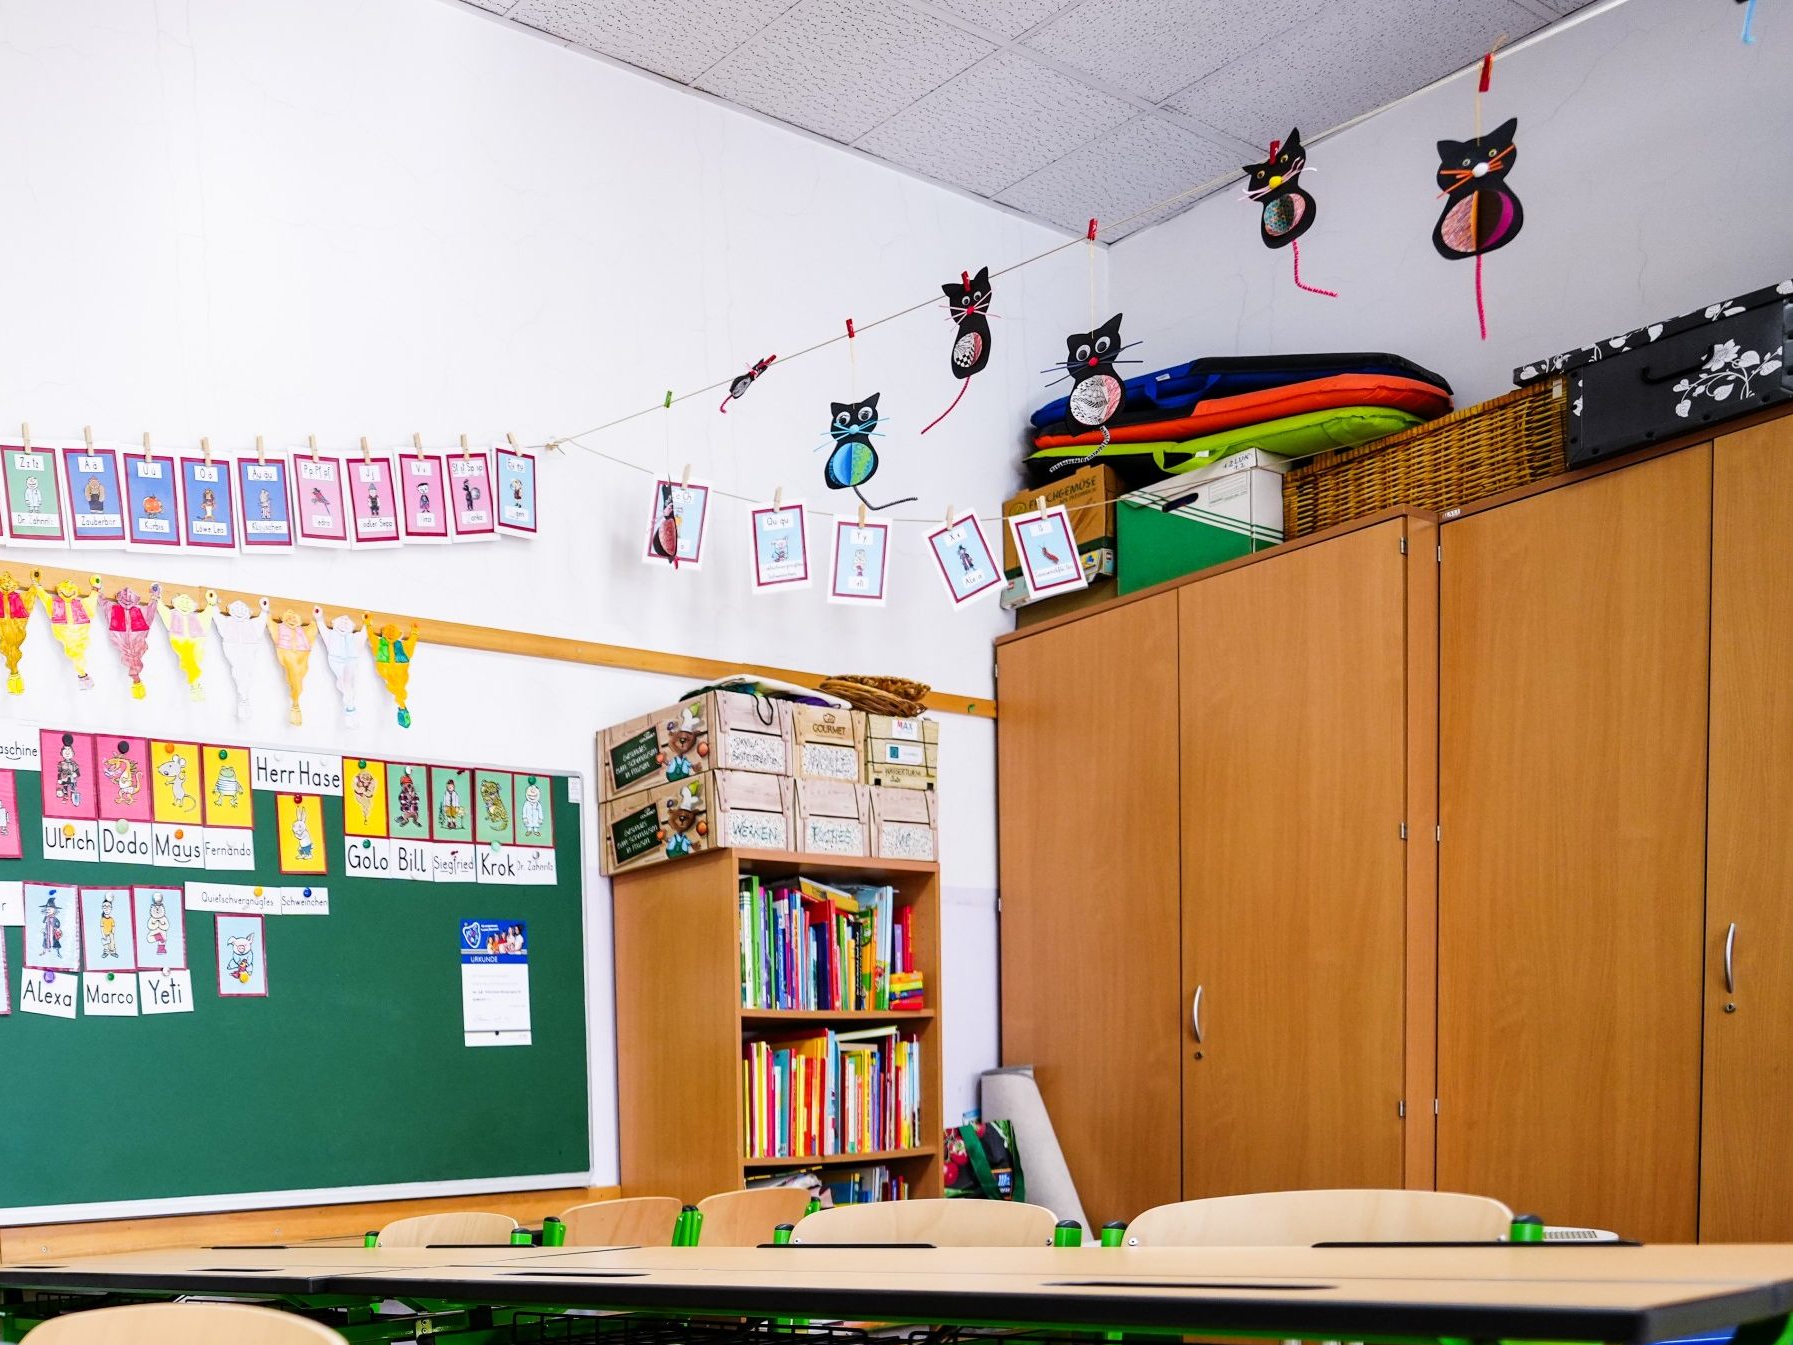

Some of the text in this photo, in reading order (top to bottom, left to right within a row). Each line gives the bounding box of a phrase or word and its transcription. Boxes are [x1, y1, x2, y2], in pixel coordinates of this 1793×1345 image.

[19, 456, 26, 467] Z
[812, 723, 847, 736] GOURMET
[256, 756, 340, 788] Herr Hase
[45, 826, 96, 852] Ulrich
[103, 828, 149, 856] Dodo
[155, 832, 201, 858] Maus
[205, 841, 252, 857] Fernando
[347, 844, 389, 871] Golo
[398, 847, 427, 873] Bill
[433, 855, 474, 873] Siegfried
[481, 852, 516, 877] Krok
[281, 895, 328, 907] Schweinchen
[23, 979, 72, 1007] Alexa
[86, 985, 134, 1005] Marco
[148, 978, 182, 1005] Yeti
